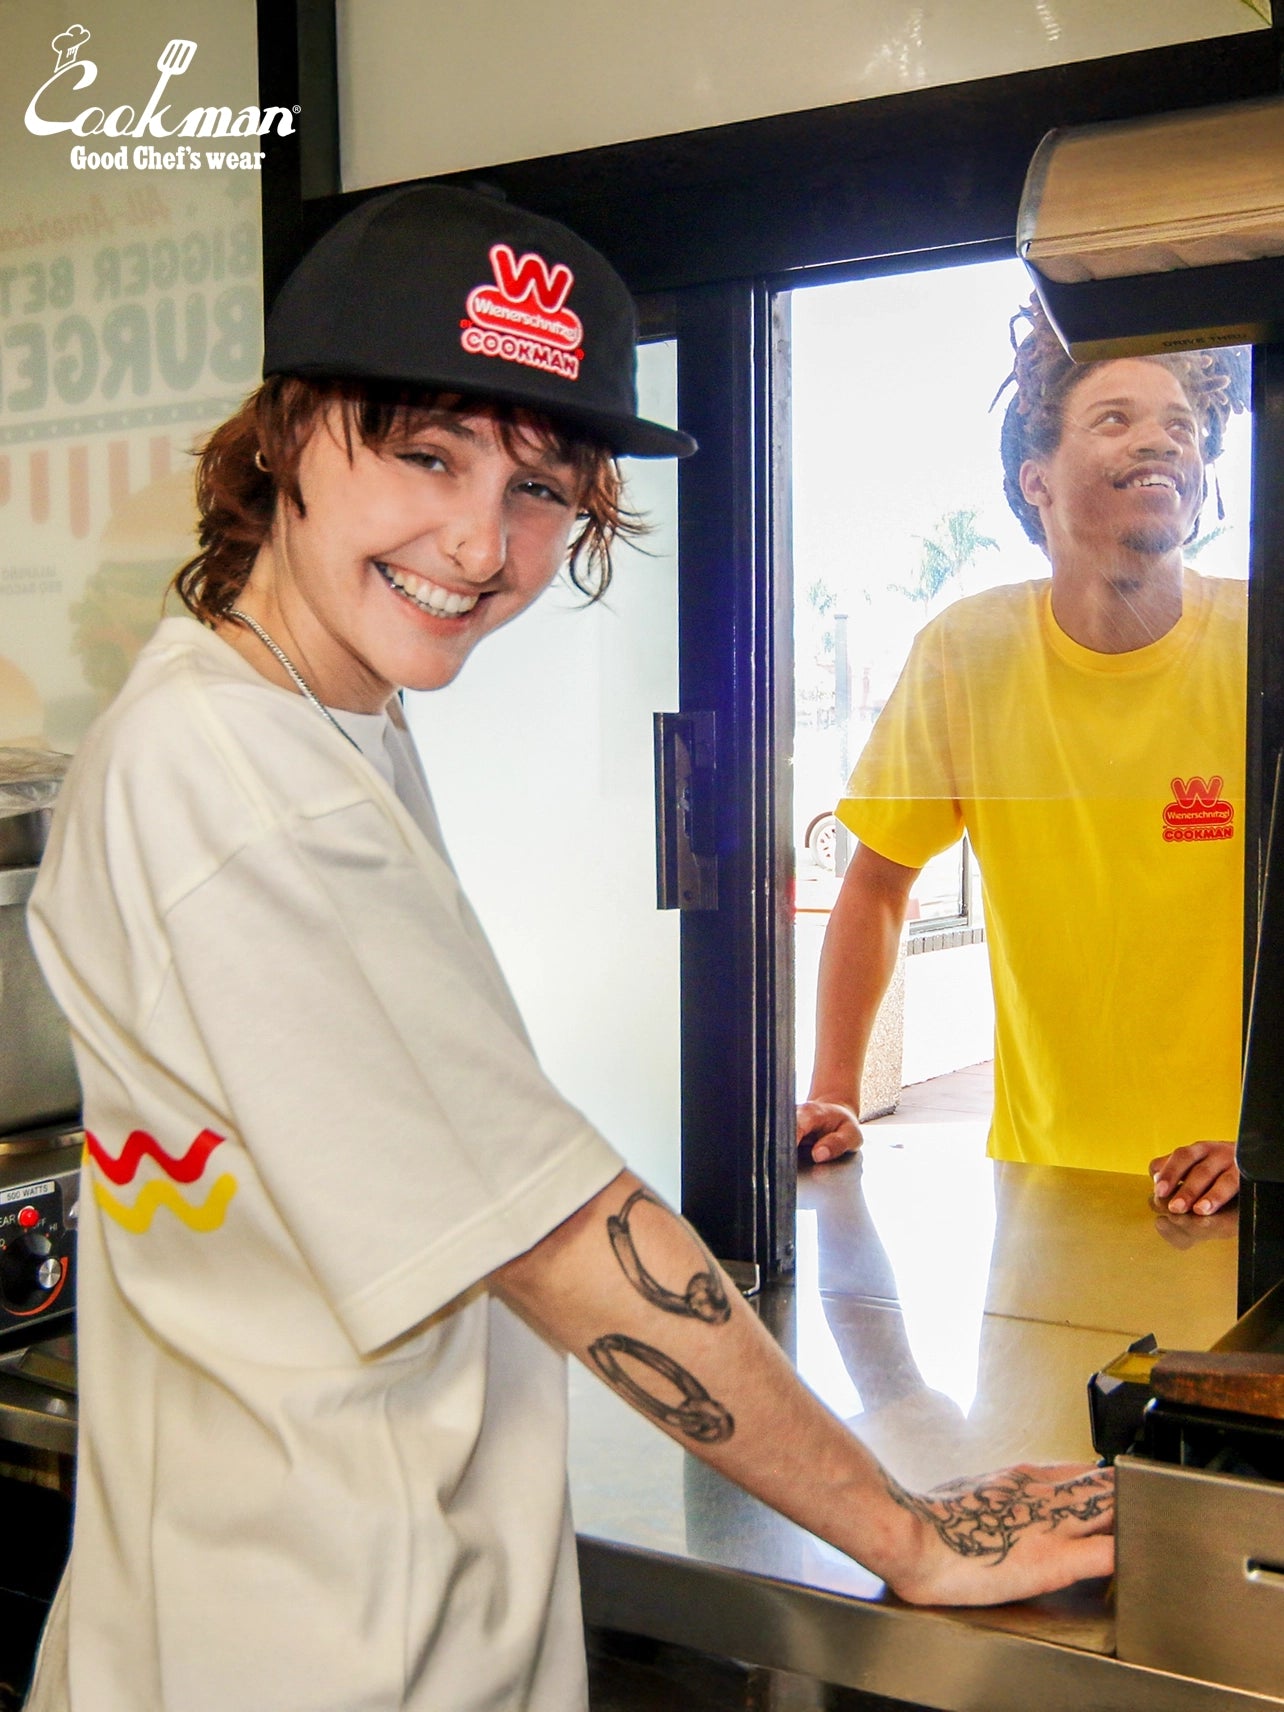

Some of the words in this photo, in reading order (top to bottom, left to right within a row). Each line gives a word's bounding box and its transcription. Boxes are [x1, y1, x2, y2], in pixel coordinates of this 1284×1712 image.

[461, 327, 578, 379] COOKMAN
[1164, 827, 1233, 841] COOKMAN
[7, 1190, 21, 1201] 500
[22, 1185, 48, 1196] WATTS
